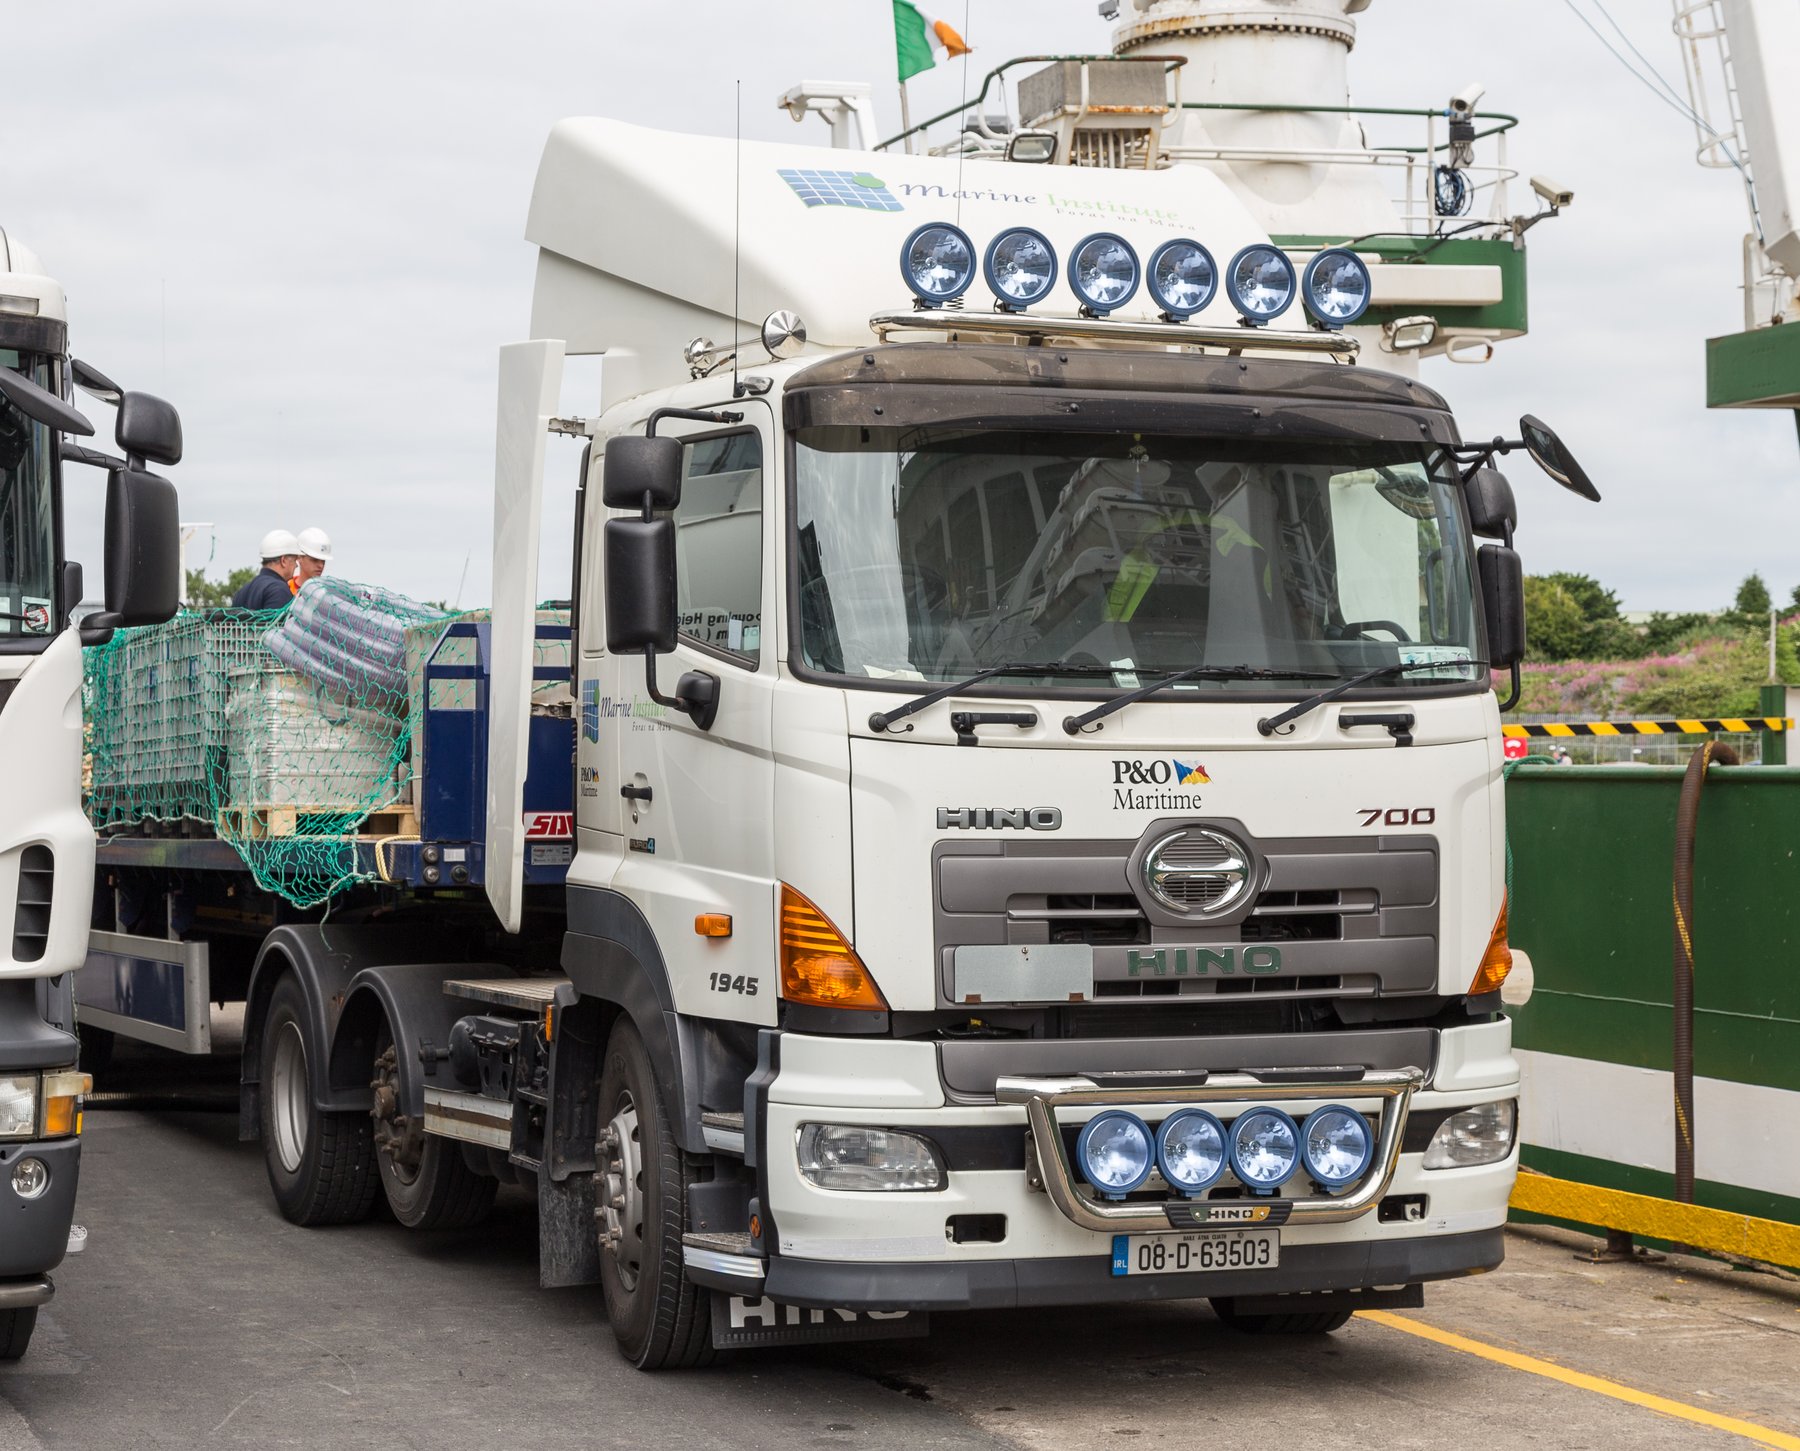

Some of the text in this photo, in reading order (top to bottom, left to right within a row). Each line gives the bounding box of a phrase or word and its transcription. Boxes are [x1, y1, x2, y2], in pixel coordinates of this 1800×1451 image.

[899, 183, 1179, 219] Marine Institute
[1056, 208, 1106, 219] Foras
[1150, 219, 1197, 231] Mara
[601, 697, 631, 718] Marine
[581, 767, 592, 782] P&O
[1112, 760, 1171, 785] P&O
[1113, 788, 1202, 811] Maritime
[936, 807, 1062, 830] HINO
[1356, 808, 1436, 827] 700
[1127, 946, 1282, 976] HINO
[709, 972, 759, 996] 1945
[1207, 1209, 1253, 1219] HINO
[1114, 1239, 1270, 1271] IRL 08-D-63503
